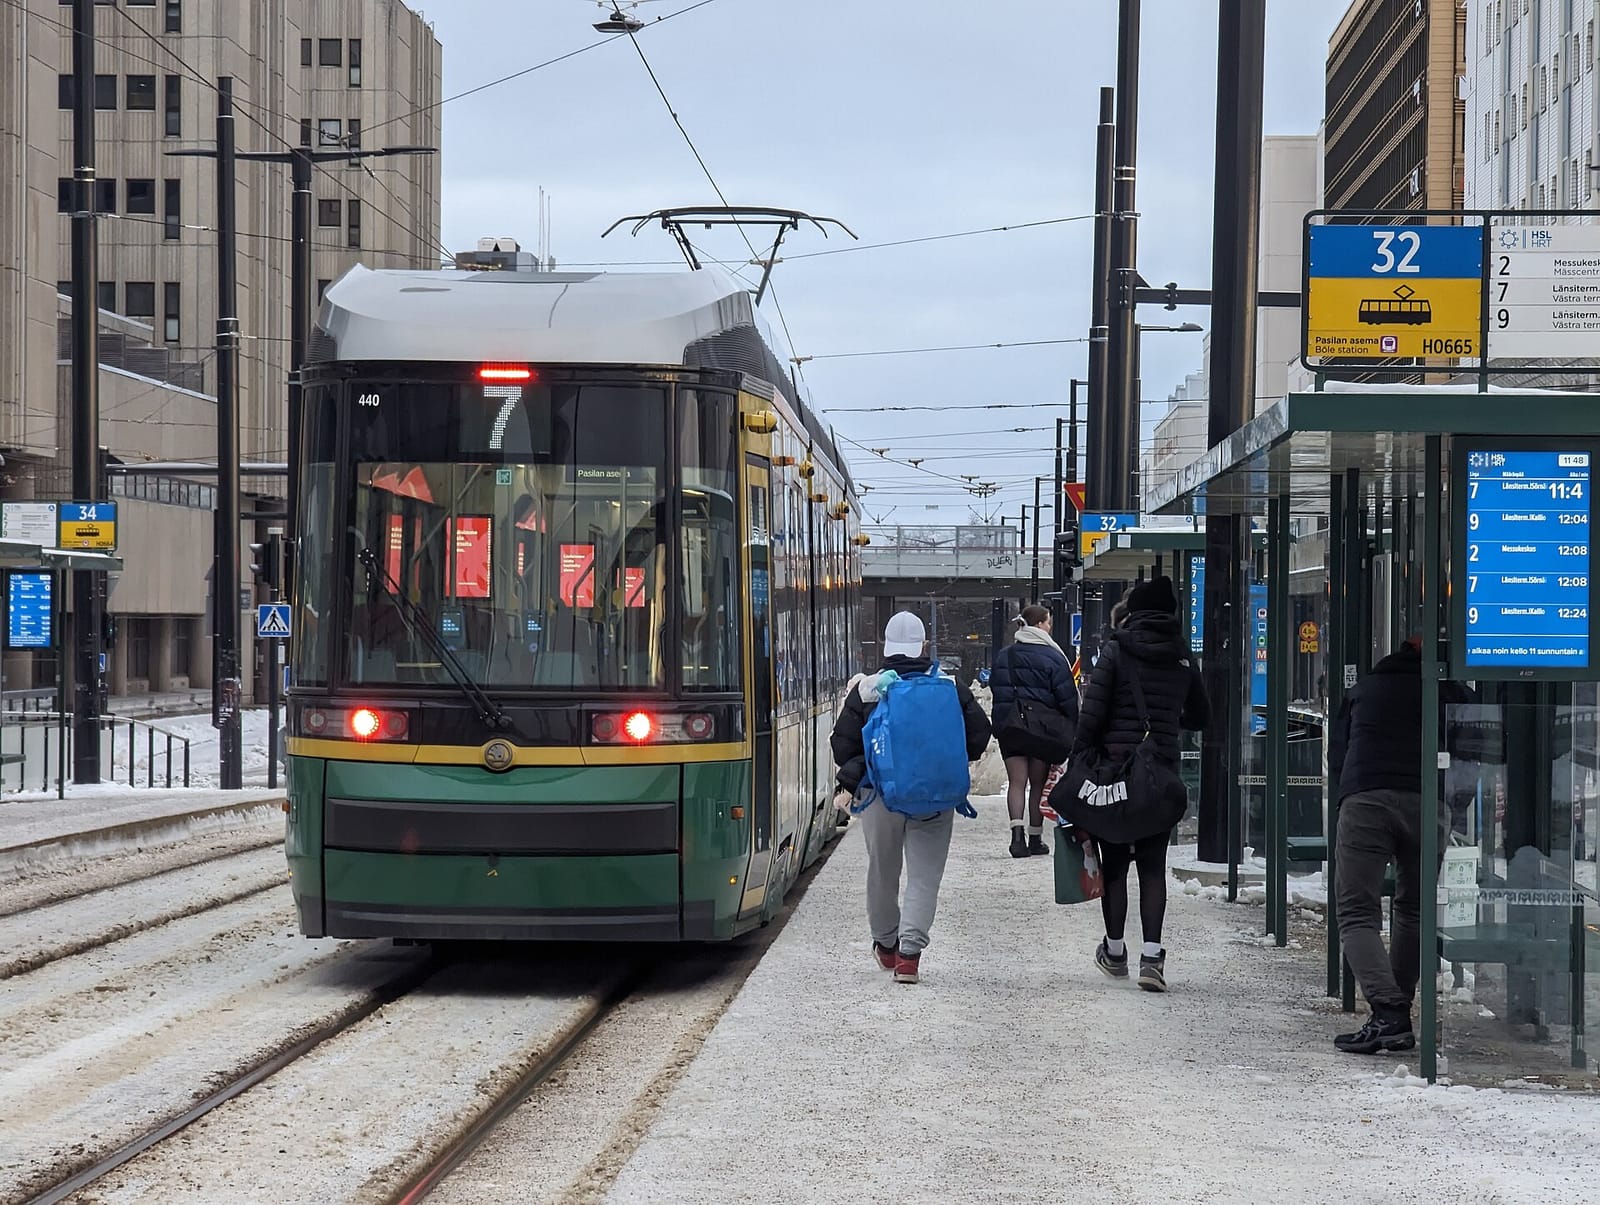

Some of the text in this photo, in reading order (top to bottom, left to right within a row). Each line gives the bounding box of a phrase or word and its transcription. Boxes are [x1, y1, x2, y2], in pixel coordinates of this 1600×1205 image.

[1531, 231, 1552, 239] HSL
[1531, 239, 1552, 248] HRT
[1371, 231, 1421, 273] 32
[1499, 256, 1511, 276] 2
[1497, 282, 1509, 302] 7
[1552, 294, 1580, 303] Västra
[1497, 308, 1510, 329] 9
[1552, 321, 1580, 329] Västra
[1315, 336, 1379, 345] Pasilan asema
[1337, 345, 1369, 354] station
[1423, 339, 1473, 354] H0665
[359, 394, 380, 406] 440
[484, 386, 522, 449] 7
[578, 469, 605, 477] Pasilan
[1470, 482, 1479, 499] 7
[1548, 482, 1583, 499] 11:4
[79, 505, 97, 520] 34
[1100, 516, 1117, 531] 32
[1469, 513, 1479, 530] 9
[1558, 514, 1588, 524] 12:04
[3, 530, 8, 538] 9
[1469, 544, 1479, 561] 2
[1558, 546, 1587, 555] 12:08
[1192, 570, 1197, 578] 7
[1191, 584, 1197, 592] 9
[1469, 576, 1478, 592] 7
[1558, 577, 1587, 587] 12:08
[1191, 598, 1197, 606] 2
[1191, 612, 1197, 620] 7
[1469, 607, 1478, 624] 9
[1558, 608, 1587, 618] 12:24
[1191, 626, 1197, 634] 9
[1471, 647, 1491, 655] alkaa
[1493, 647, 1509, 655] noin
[1510, 647, 1528, 655] kello
[1529, 647, 1536, 655] 11
[1537, 647, 1577, 655] sunnuntain
